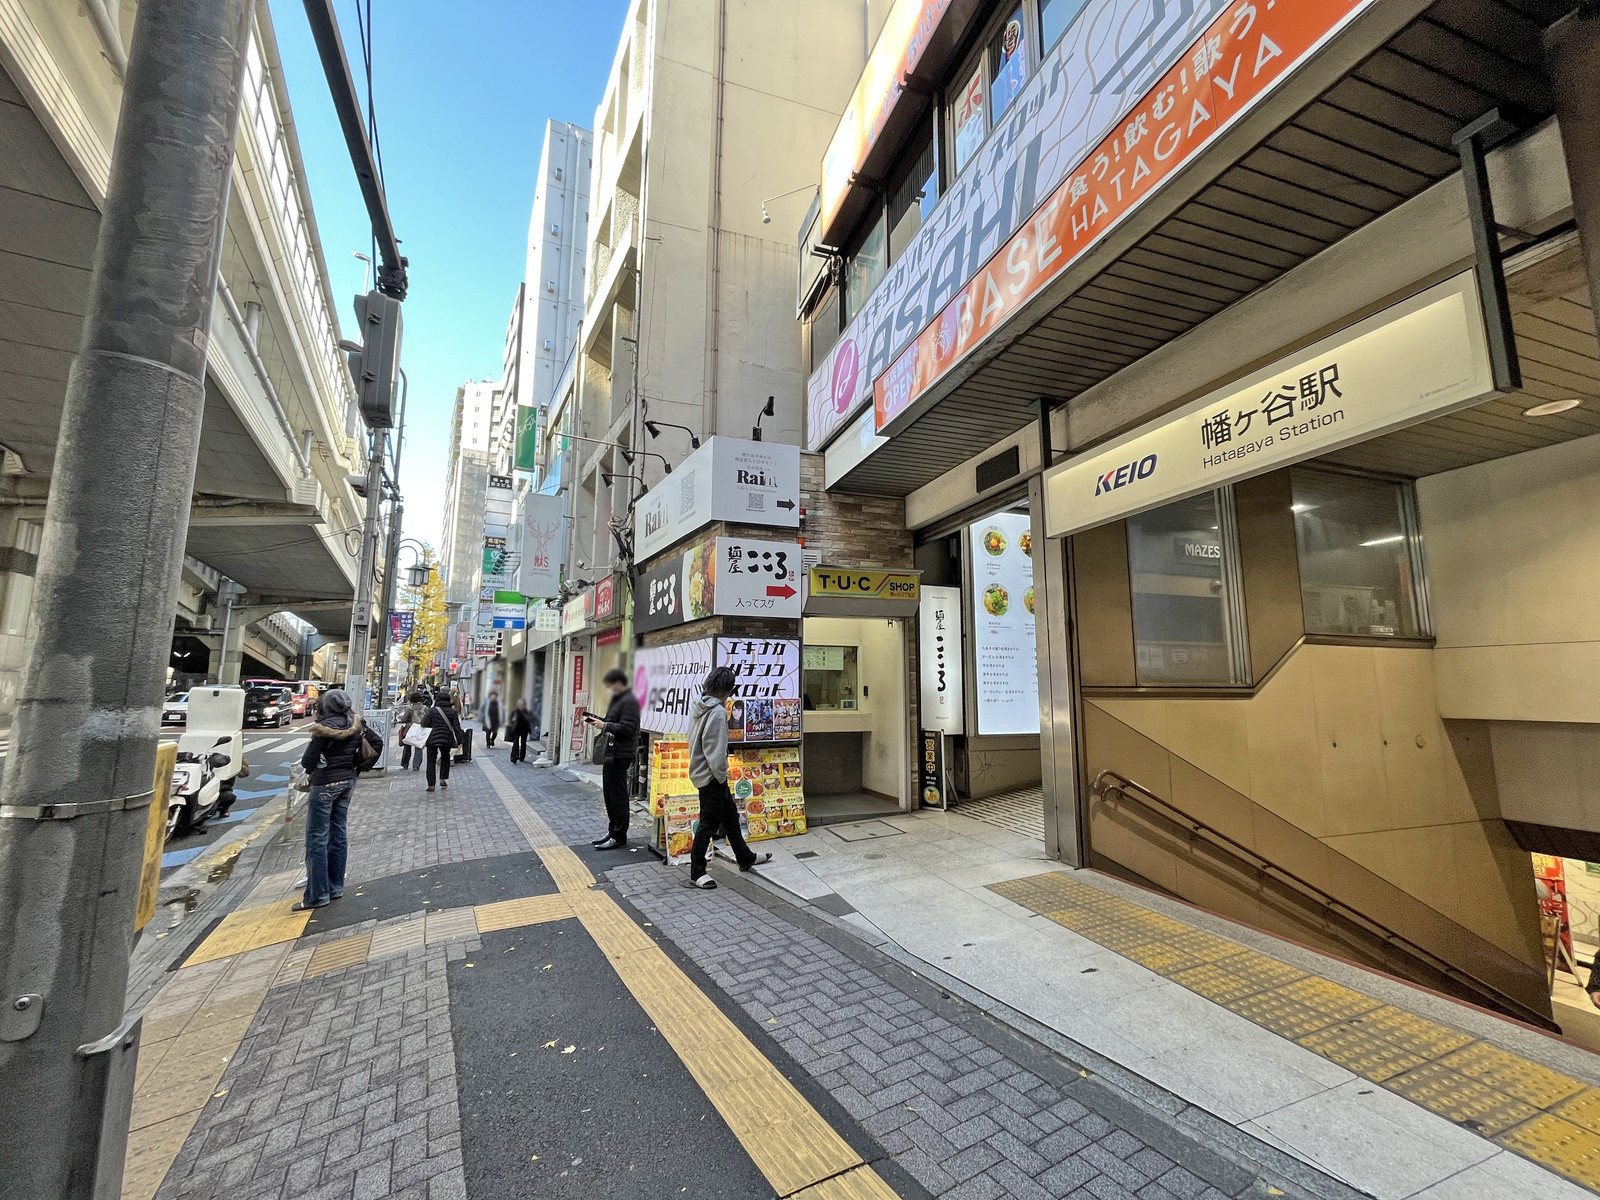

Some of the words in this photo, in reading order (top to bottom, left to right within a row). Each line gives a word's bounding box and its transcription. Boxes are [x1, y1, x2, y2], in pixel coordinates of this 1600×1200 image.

[1071, 33, 1283, 241] HATAGAYA
[865, 129, 1043, 389] ASAHI
[956, 198, 1062, 346] BASE
[862, 264, 906, 334] エキナカ
[883, 361, 921, 413] OPEN!
[1201, 363, 1343, 449] 幡ヶ谷駅
[1203, 433, 1274, 469] Hatagaya
[1279, 409, 1345, 441] Station
[1094, 453, 1158, 497] KEIO
[747, 550, 788, 580] こころ
[1184, 543, 1220, 559] MAZES
[656, 573, 677, 616] こころ
[735, 597, 775, 609] 入ってスグ
[889, 582, 915, 592] SHOP
[727, 641, 787, 656] エキナカ
[729, 659, 786, 677] パチンコ
[936, 635, 946, 692] こころ
[729, 683, 787, 697] スロット
[925, 738, 936, 774] 営業中
